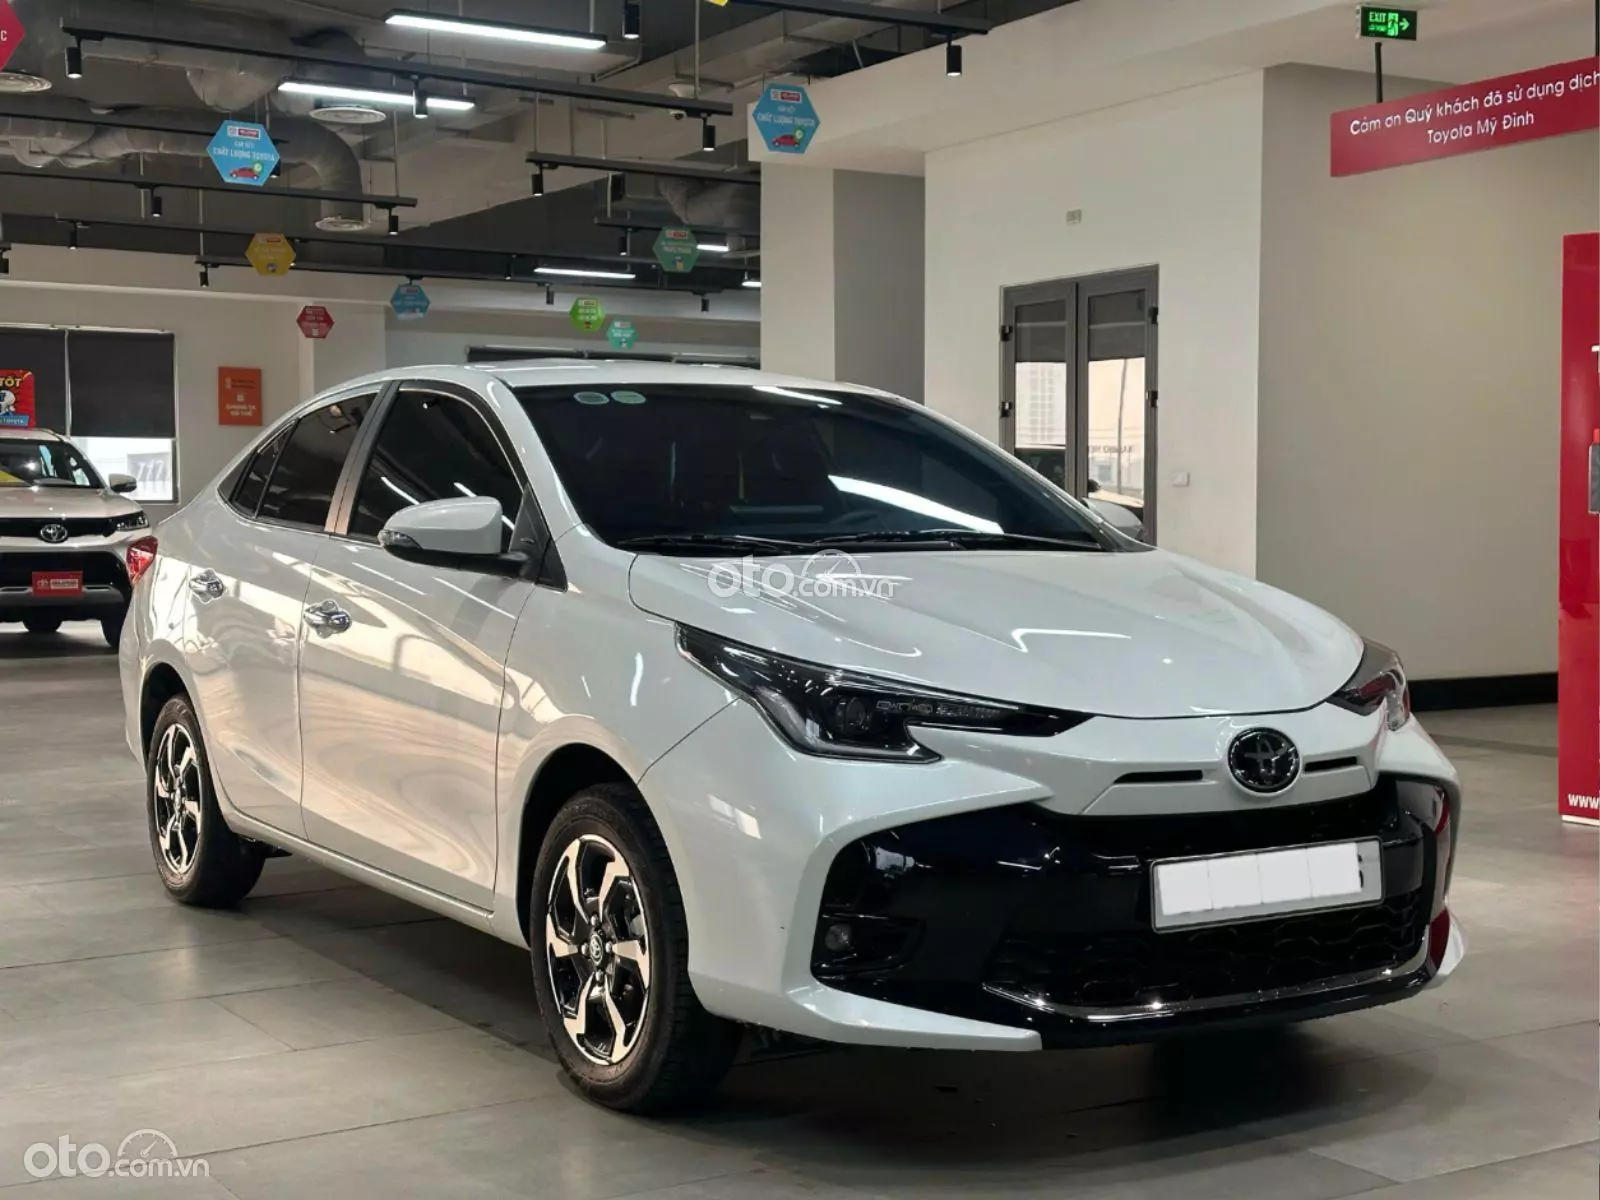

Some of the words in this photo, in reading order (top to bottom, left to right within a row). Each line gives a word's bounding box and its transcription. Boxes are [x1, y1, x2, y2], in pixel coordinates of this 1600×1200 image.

[1369, 11, 1387, 23] EXIT
[1350, 115, 1381, 135] Cảm
[1384, 112, 1402, 128] ơn
[1405, 103, 1433, 124] Quý
[1437, 96, 1479, 118] khách
[1483, 89, 1503, 108] đã
[1507, 83, 1524, 103] sử
[1526, 79, 1565, 101] dụng
[1569, 69, 1600, 93] dịch
[1427, 123, 1473, 145] Toyota
[1476, 116, 1498, 136] Mỹ
[1502, 111, 1535, 131] Đình
